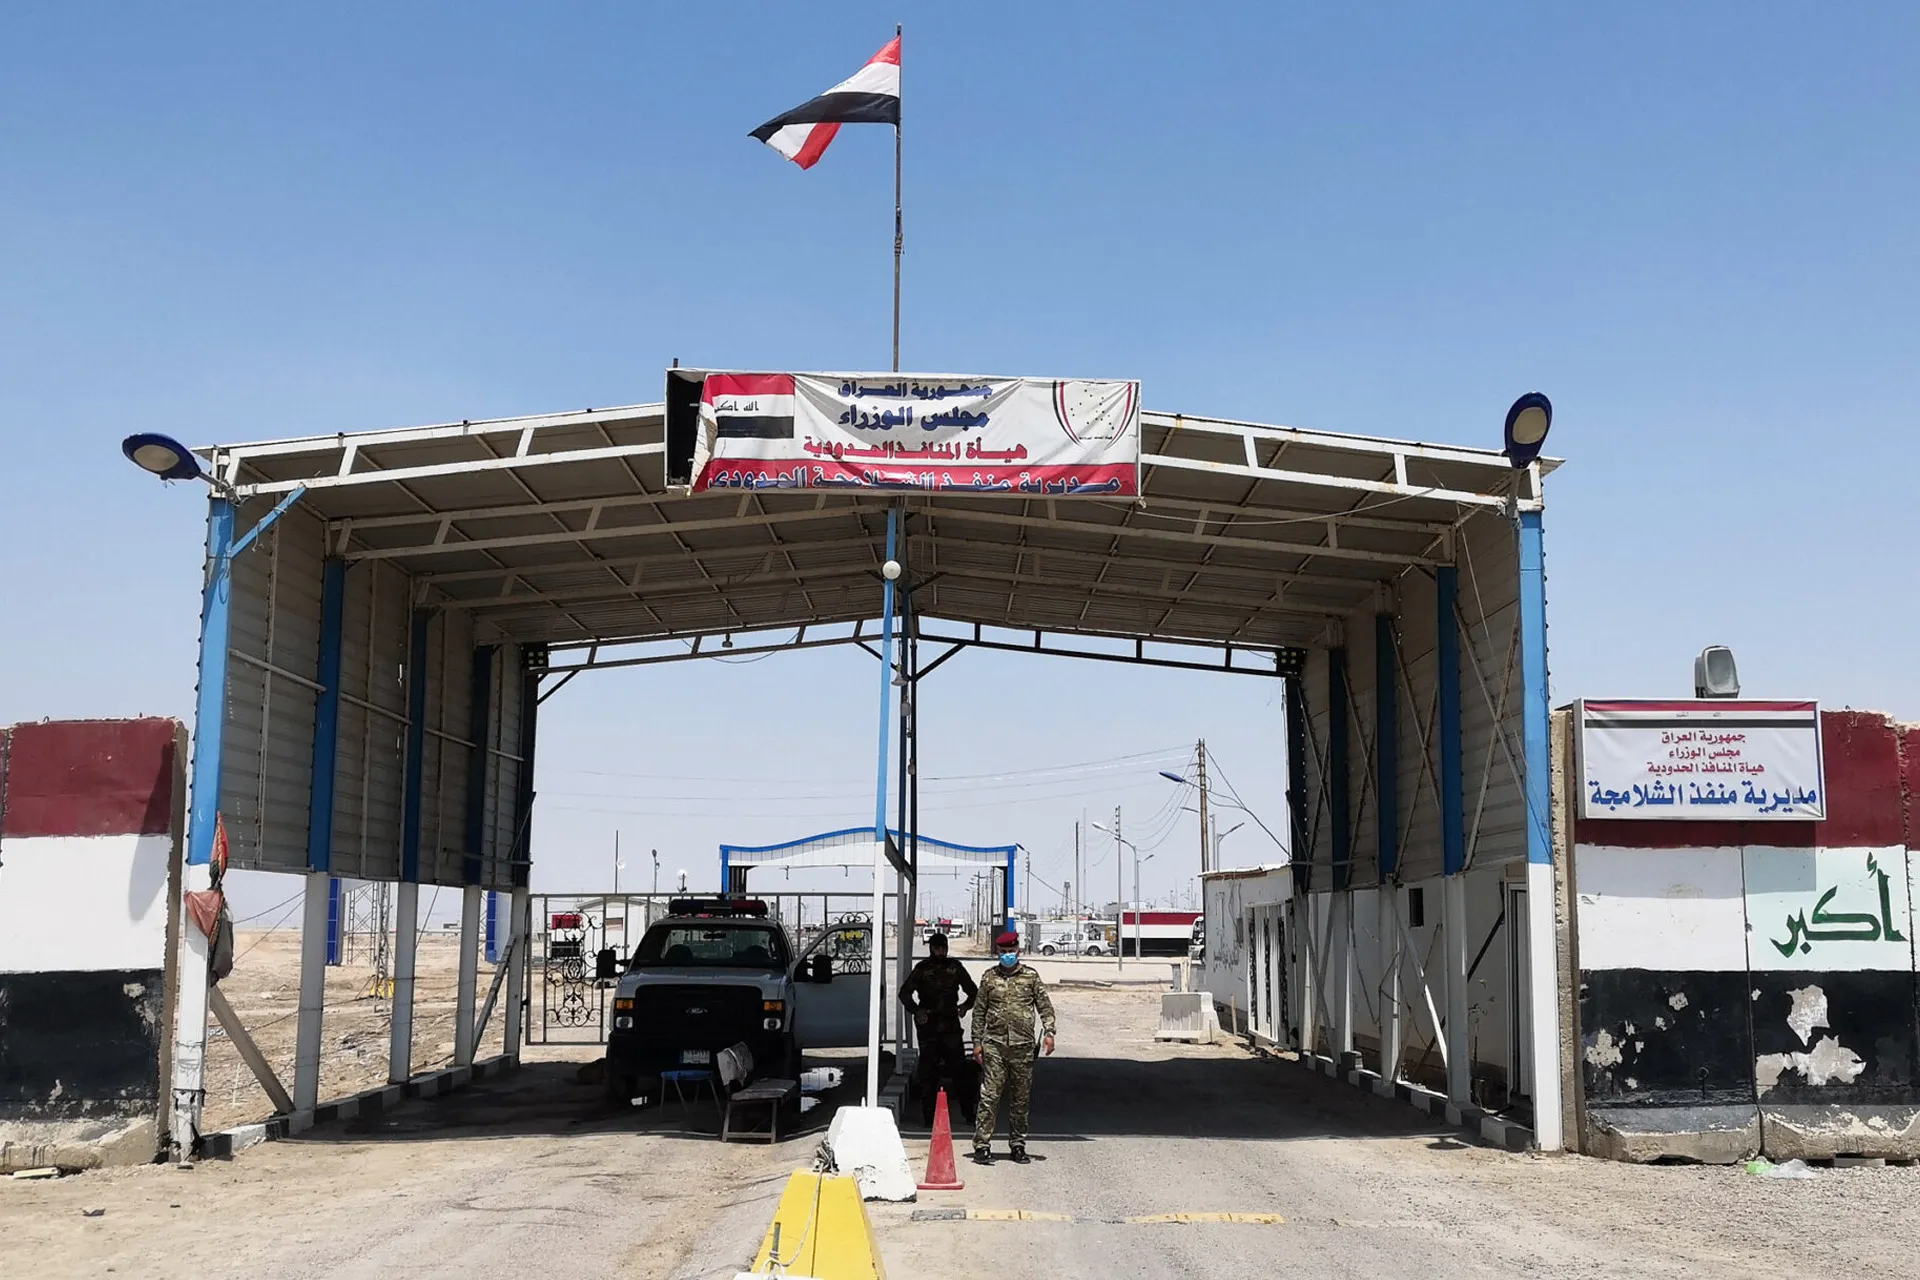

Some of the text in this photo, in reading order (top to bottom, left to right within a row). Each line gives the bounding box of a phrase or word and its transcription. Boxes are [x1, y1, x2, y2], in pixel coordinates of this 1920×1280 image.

[838, 380, 993, 400] جمهورية العراق
[838, 404, 990, 431] مجلس الوزراء
[803, 437, 893, 465] الحدودية
[893, 441, 960, 460] المنافذ
[940, 472, 1012, 492] منفذ
[1661, 731, 1746, 745] جمهورية العراق
[1669, 747, 1741, 759] مجلس الوزراء
[1647, 762, 1765, 776] هيأة المنافذ الحدودية
[1588, 780, 1817, 813] مديرية منفذ الشلامجة
[1769, 851, 1908, 958] أكبر
